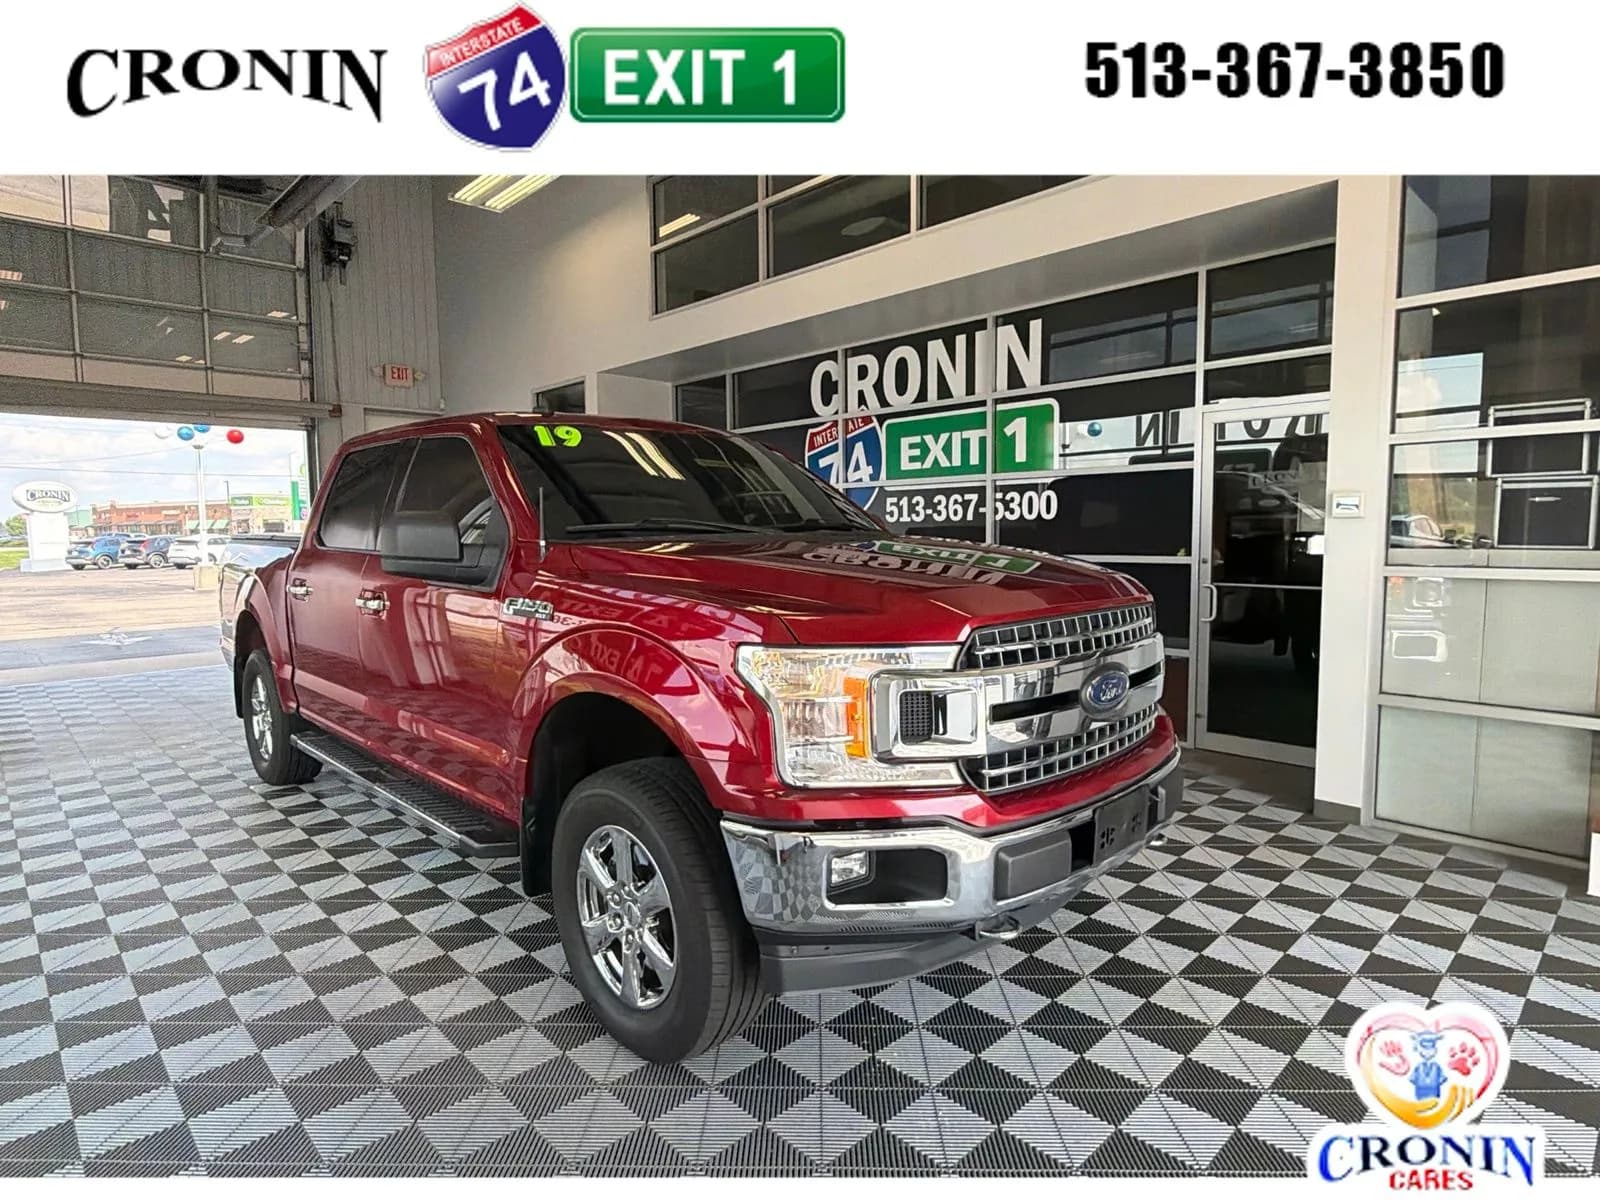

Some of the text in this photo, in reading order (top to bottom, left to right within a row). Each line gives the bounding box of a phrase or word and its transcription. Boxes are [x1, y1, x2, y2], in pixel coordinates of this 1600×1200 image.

[391, 366, 409, 381] EXIT
[810, 317, 1043, 418] CRONIN
[533, 425, 583, 448] 19
[813, 417, 865, 448] INTERATE
[900, 416, 1028, 471] EXIT 1
[818, 441, 874, 485] 74
[26, 489, 71, 502] CRONIN
